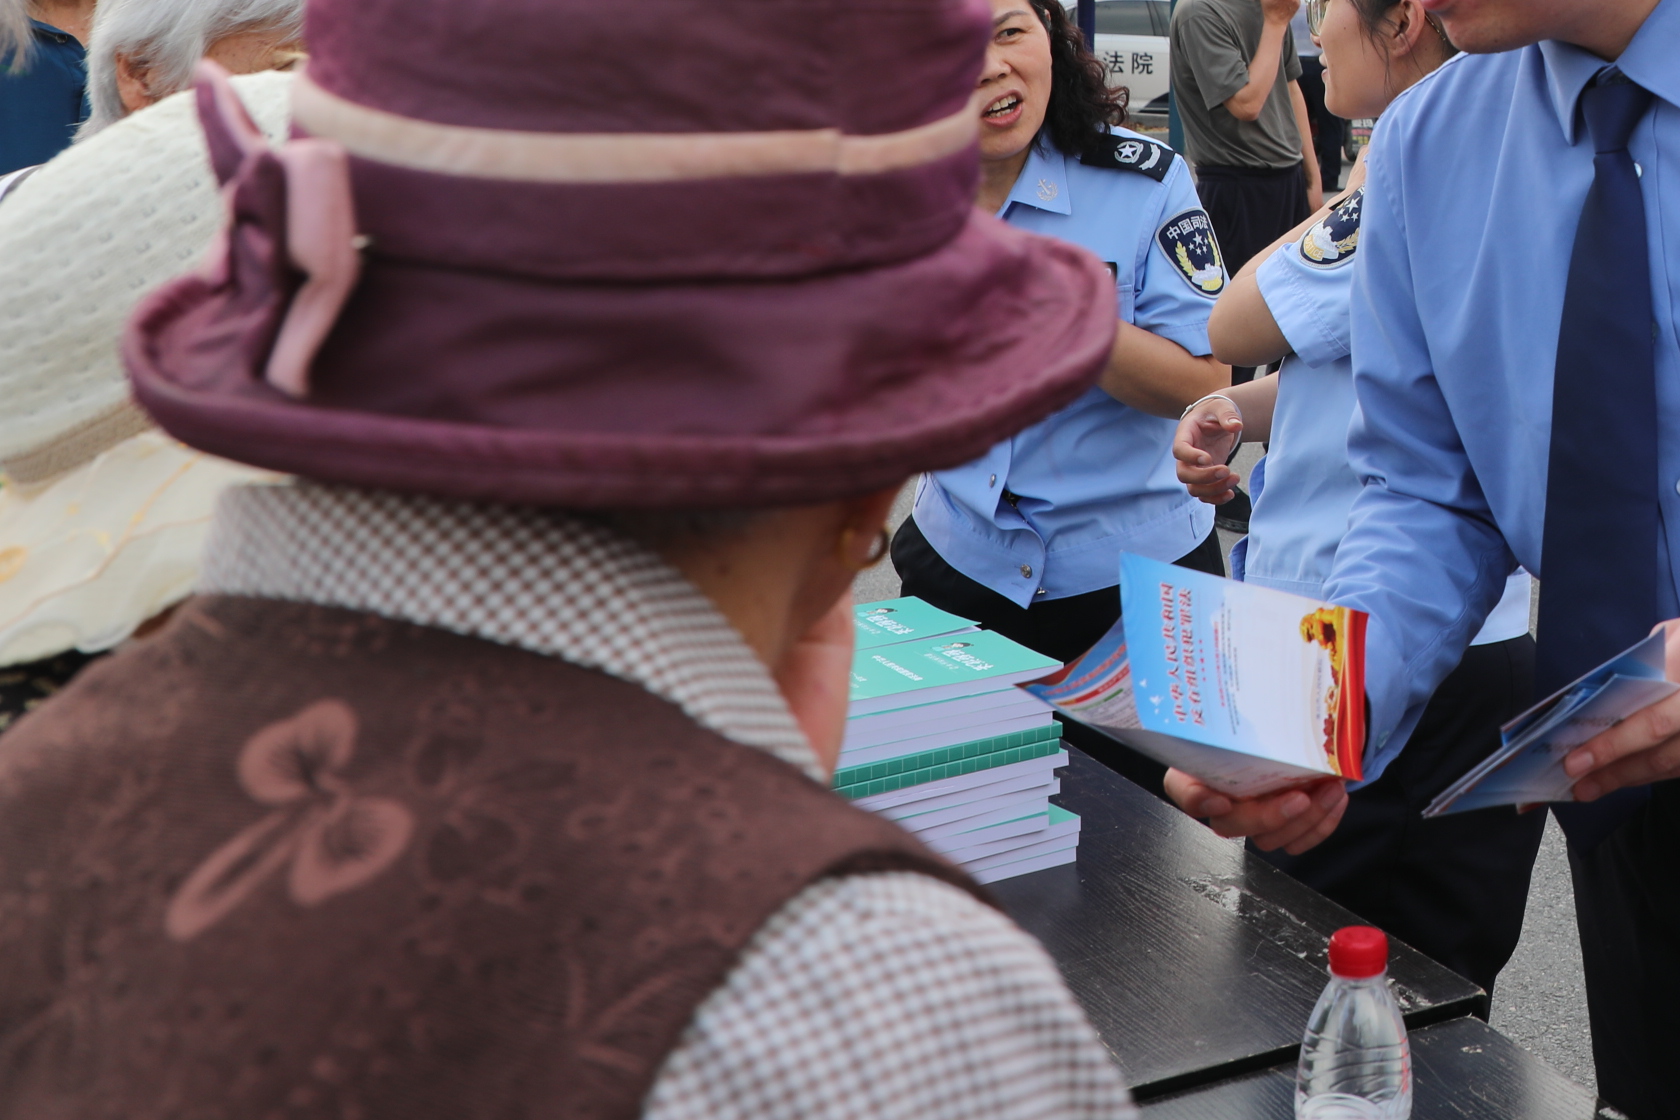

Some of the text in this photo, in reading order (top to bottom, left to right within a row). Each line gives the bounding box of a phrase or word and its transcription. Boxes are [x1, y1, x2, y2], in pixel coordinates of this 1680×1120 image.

[1103, 51, 1153, 75] 法院
[1166, 215, 1208, 240] 中国司法
